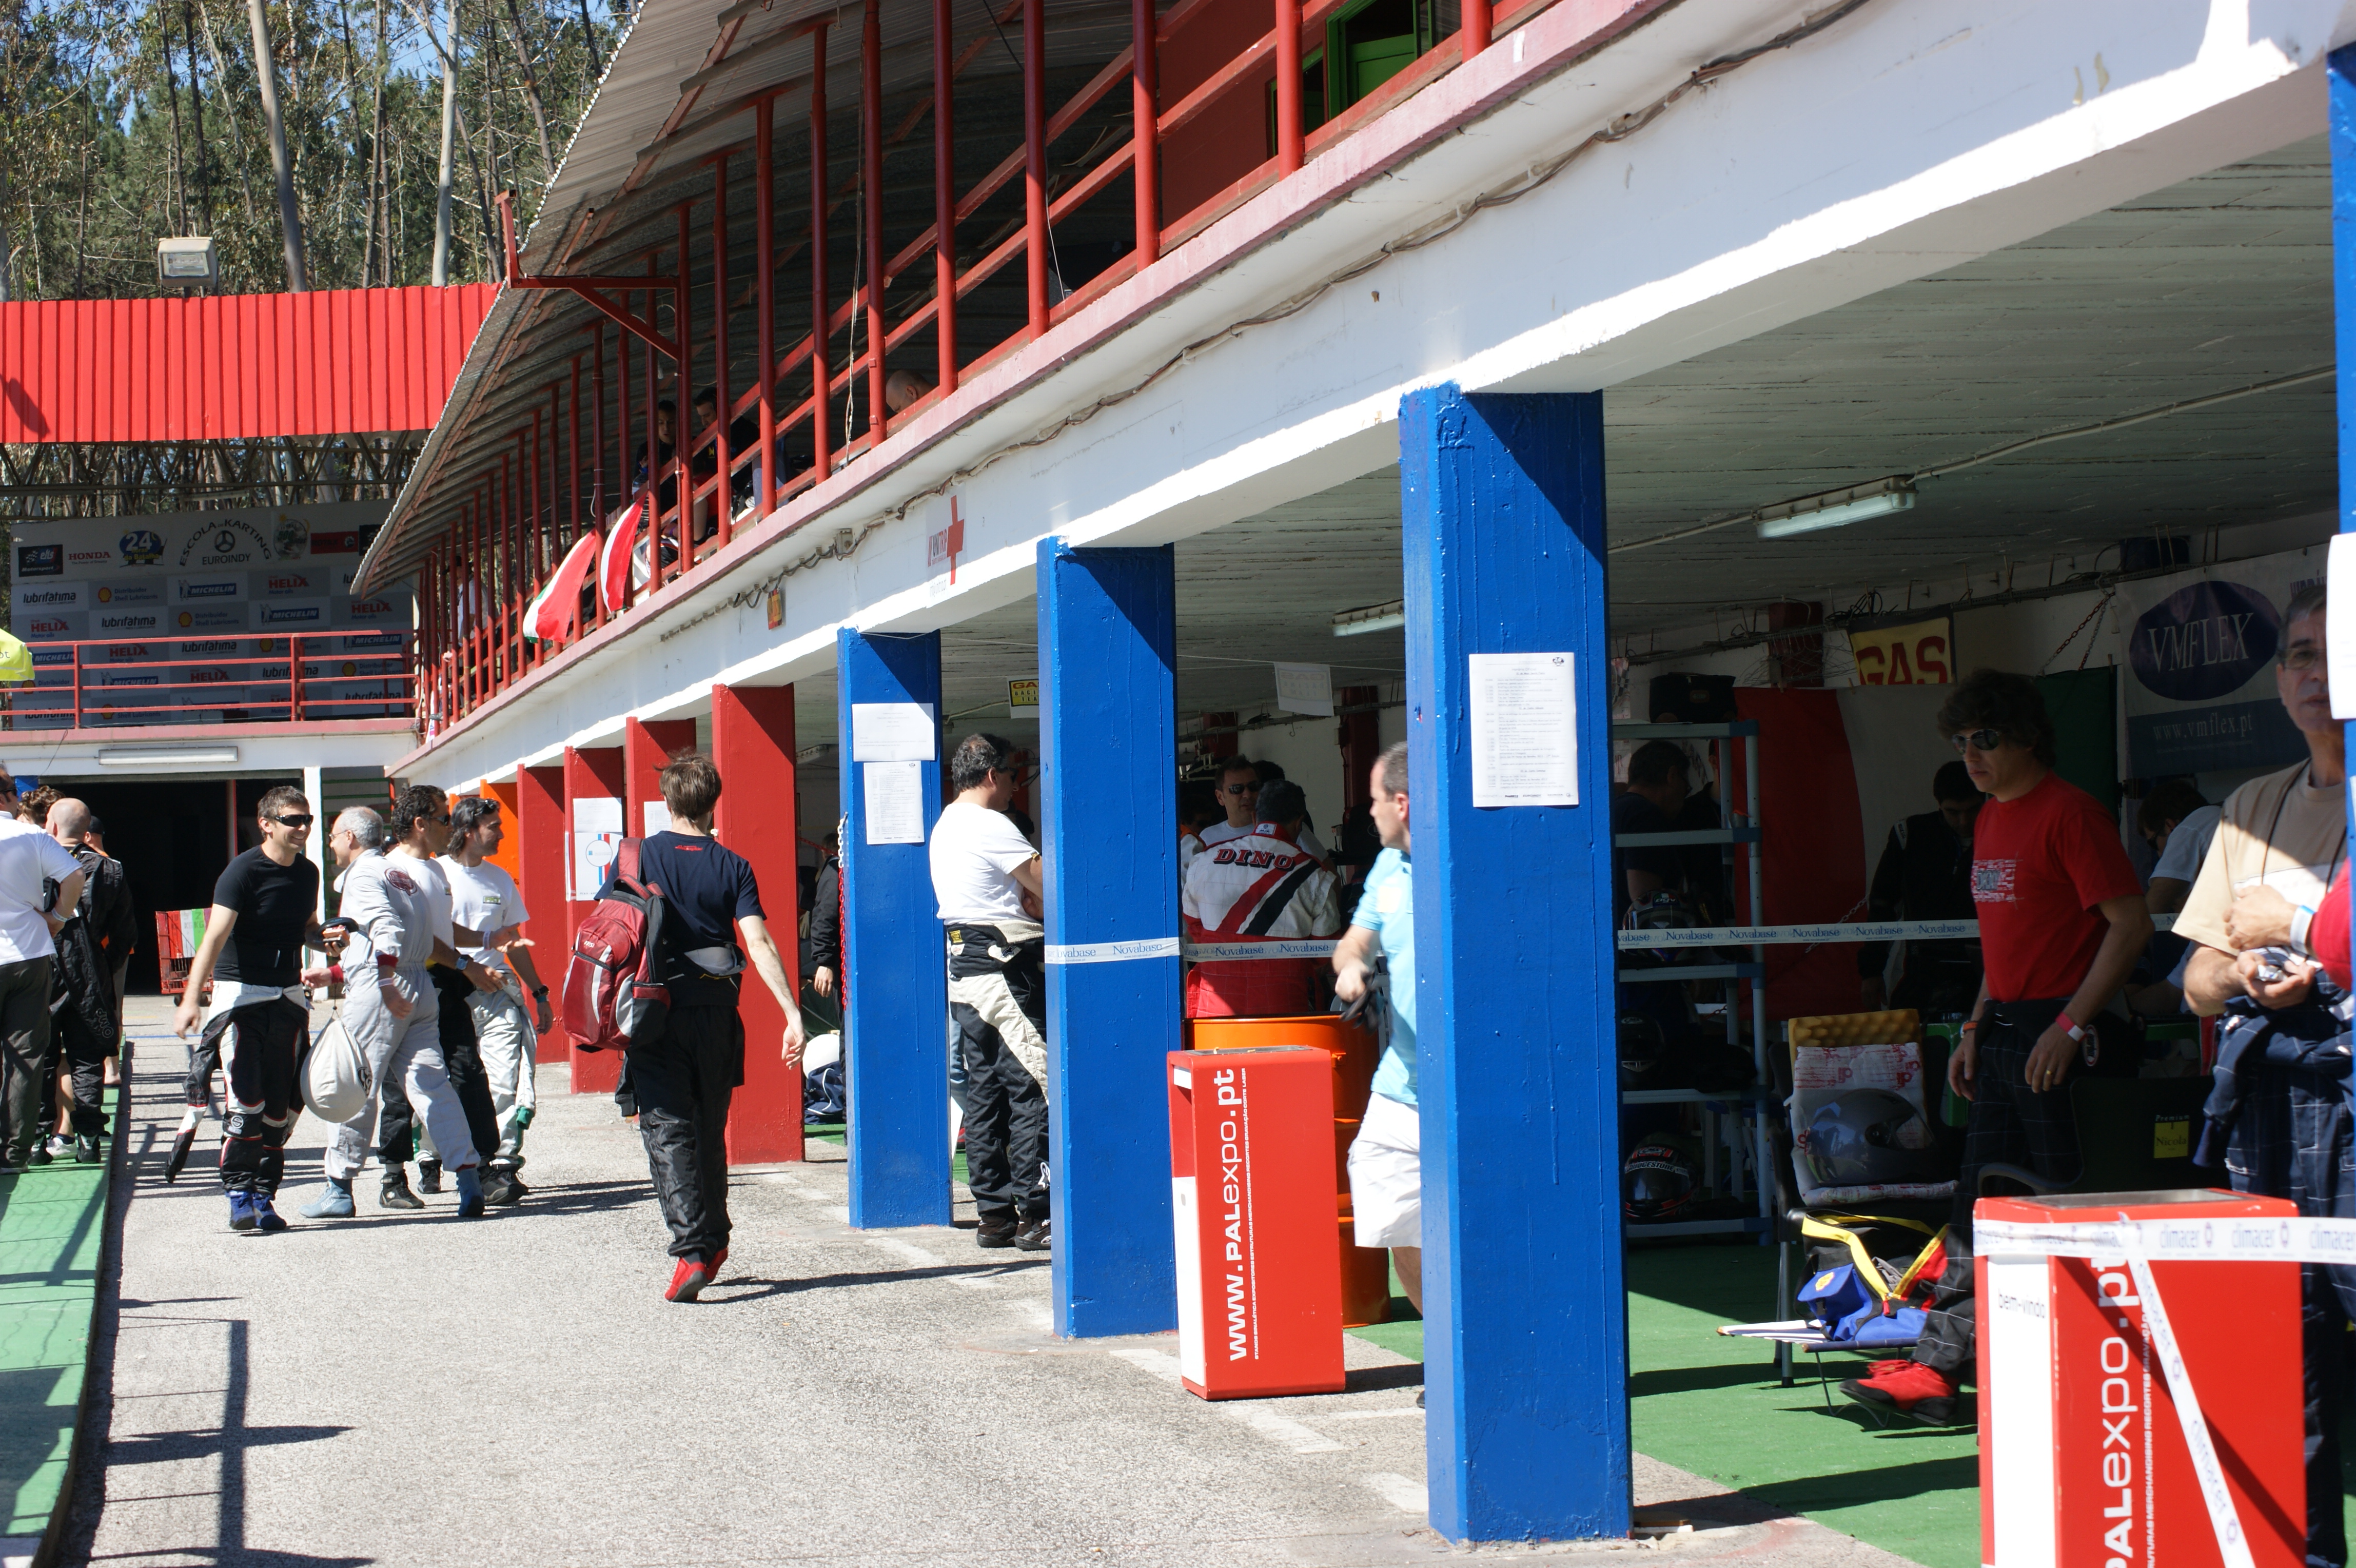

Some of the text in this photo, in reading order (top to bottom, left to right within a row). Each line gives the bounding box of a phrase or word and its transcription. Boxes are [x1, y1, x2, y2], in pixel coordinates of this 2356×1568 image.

[126, 532, 152, 552] 24
[180, 521, 217, 566] ESCOLA
[225, 519, 272, 560] KARTING
[68, 552, 111, 561] HONDA
[202, 553, 252, 565] EUROINDY
[190, 584, 235, 594] MICHELIN
[268, 575, 309, 589] HELIX
[23, 591, 76, 604] lubrifatima
[351, 600, 392, 614] HELIX
[272, 610, 318, 619] MICHELIN
[31, 618, 69, 633] HELIX
[101, 616, 156, 628] lubrifatima
[182, 640, 237, 653] lubrifatima
[355, 635, 400, 644] MICHELIN
[2148, 612, 2254, 673] VMFLEX
[109, 644, 149, 657] HELIX
[1856, 636, 1948, 685] GAS
[190, 668, 230, 682] HELIX
[2153, 712, 2253, 740] www.vmflex.pt
[1213, 848, 1297, 871] DINO
[1618, 924, 1965, 942] vabase Novabase Novabase Novabase Novabase Novabase
[1112, 943, 1163, 955] Novabase
[1215, 945, 1264, 956] Novabase
[1280, 943, 1329, 953] Novabase
[2156, 1135, 2187, 1146] Nicola
[1213, 1068, 1247, 1361] www.PALexpo.pt
[1997, 1288, 2046, 1319] bem-vindo
[2143, 1373, 2153, 1429] RECORTES
[2144, 1430, 2154, 1520] MERCHANDISING
